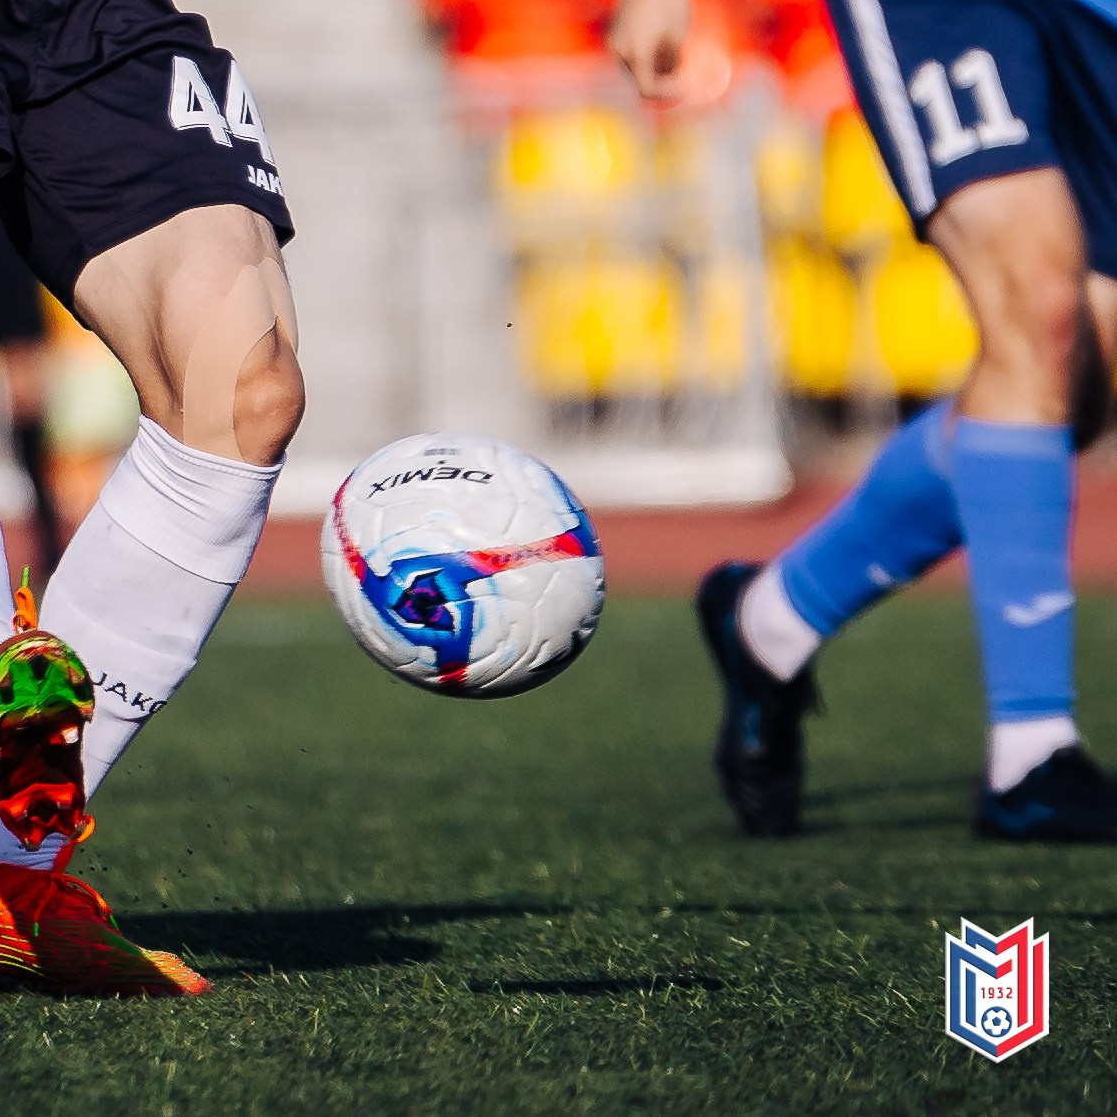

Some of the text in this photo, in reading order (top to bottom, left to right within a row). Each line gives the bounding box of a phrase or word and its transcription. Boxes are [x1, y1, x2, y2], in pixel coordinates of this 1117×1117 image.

[169, 56, 276, 166] 44
[907, 46, 1030, 167] 11
[247, 164, 284, 196] JAK
[366, 467, 494, 499] DEMIX
[92, 672, 168, 714] JAKO
